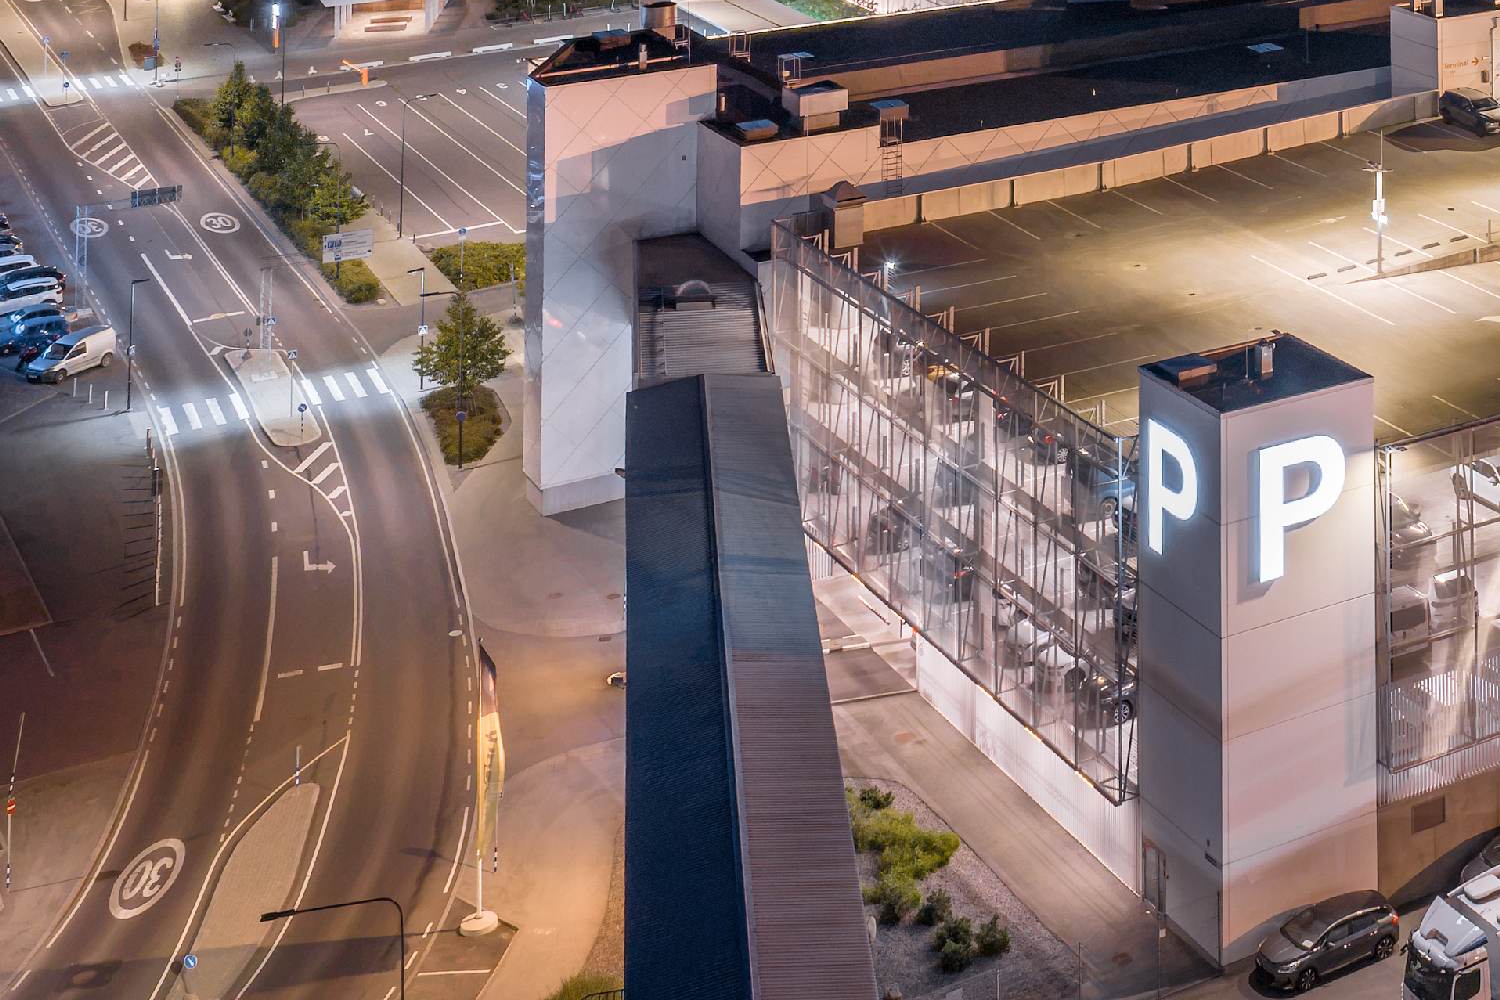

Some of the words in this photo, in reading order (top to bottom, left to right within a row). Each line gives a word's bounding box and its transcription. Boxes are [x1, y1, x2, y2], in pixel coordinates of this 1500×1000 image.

[206, 216, 232, 229] 30
[1148, 417, 1198, 557] P
[1259, 434, 1346, 584] P
[122, 856, 174, 901] 30
